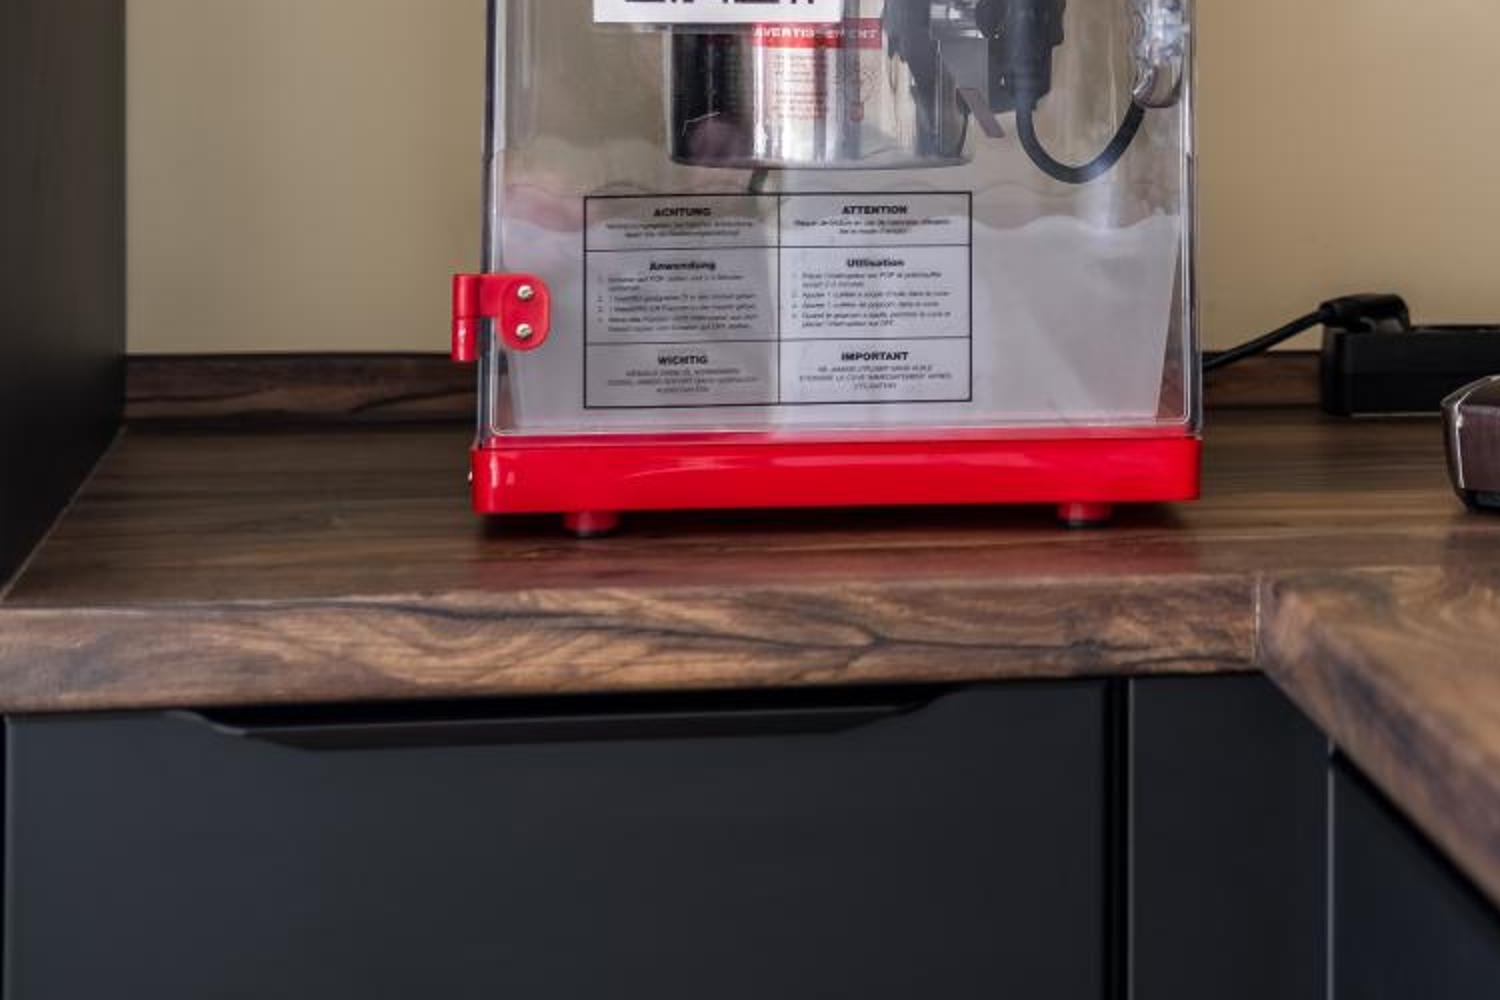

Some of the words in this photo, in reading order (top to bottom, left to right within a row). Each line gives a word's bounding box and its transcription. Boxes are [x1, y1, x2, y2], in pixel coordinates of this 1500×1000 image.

[653, 207, 712, 218] ACHTUNG
[842, 205, 908, 215] ATTENTION
[650, 261, 717, 272] Anwendung
[846, 259, 905, 268] Utilisation
[657, 354, 709, 366] WICHTIG
[841, 351, 909, 362] IMPORTANT
